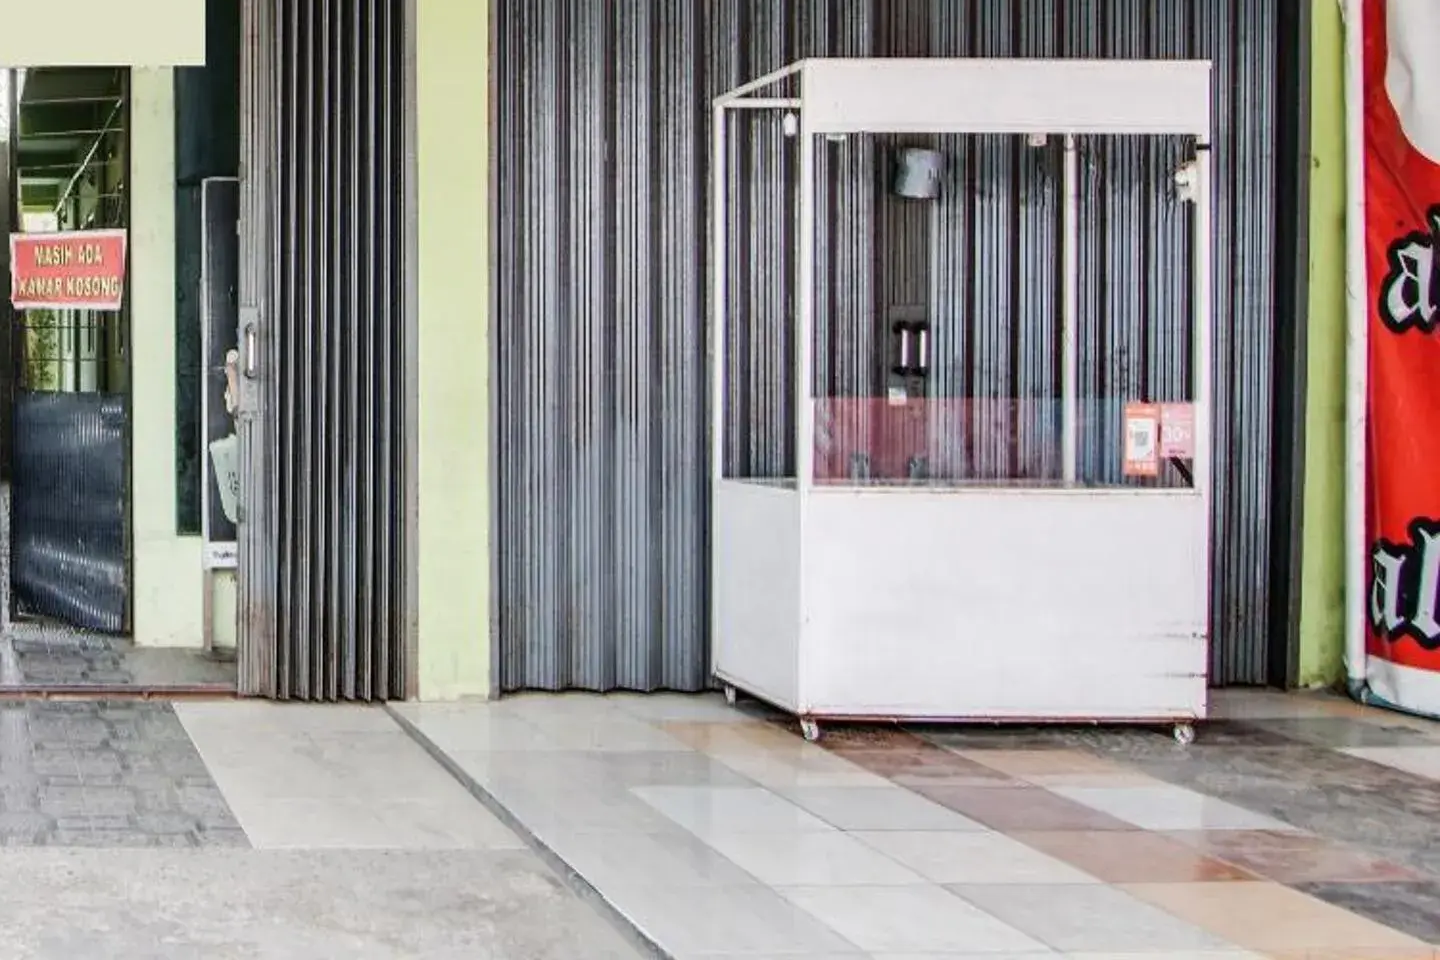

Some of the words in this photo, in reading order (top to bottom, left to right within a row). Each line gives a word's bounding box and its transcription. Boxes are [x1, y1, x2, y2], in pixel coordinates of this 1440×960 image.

[34, 244, 72, 266] MASIH
[79, 243, 102, 264] ADA
[18, 277, 62, 297] KAMAR
[66, 275, 119, 297] KOSONG
